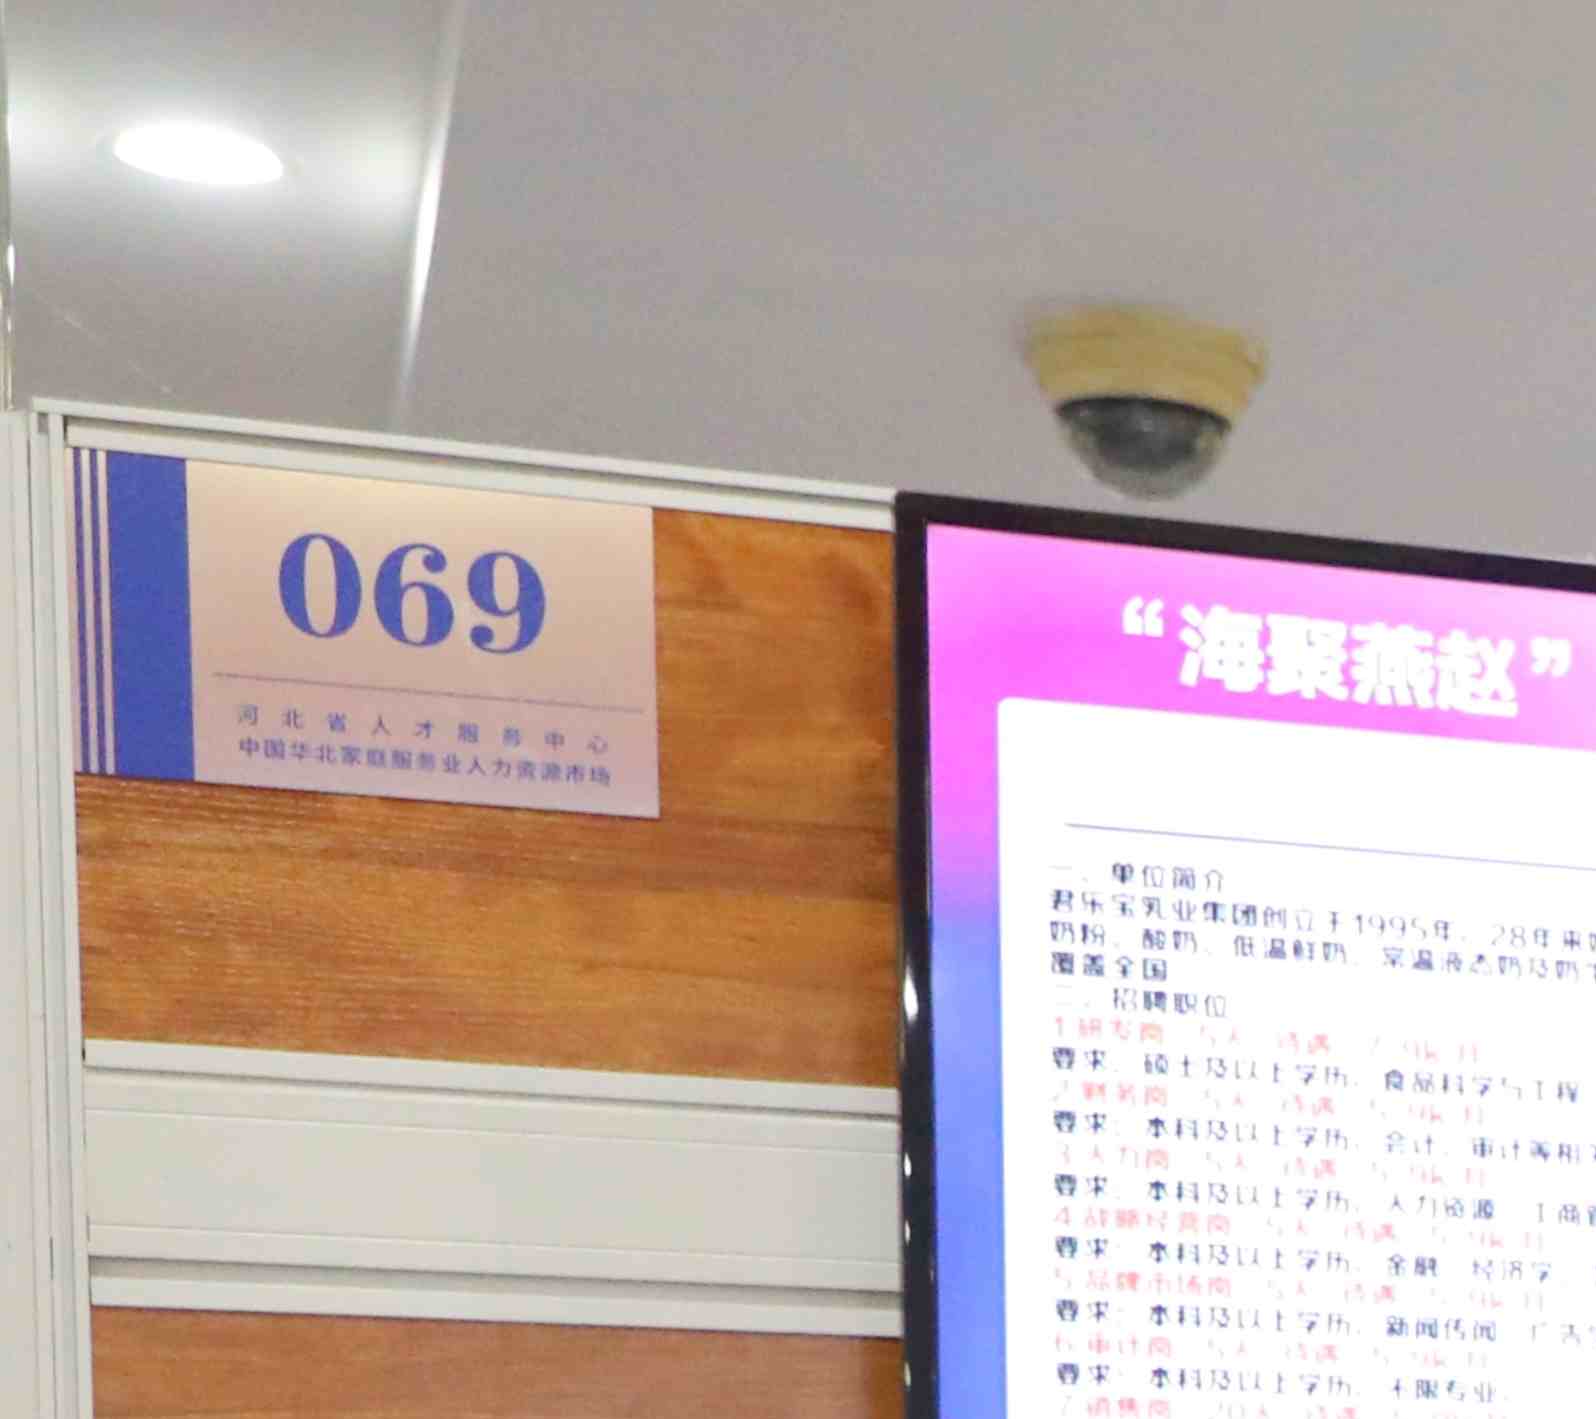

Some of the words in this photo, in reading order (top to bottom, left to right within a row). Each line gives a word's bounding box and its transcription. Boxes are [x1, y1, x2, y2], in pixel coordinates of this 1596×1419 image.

[279, 532, 546, 655] 069
[237, 702, 609, 754] 河北省人才服务中心
[238, 736, 612, 788] 中国华北家庭服务业人力资源市场
